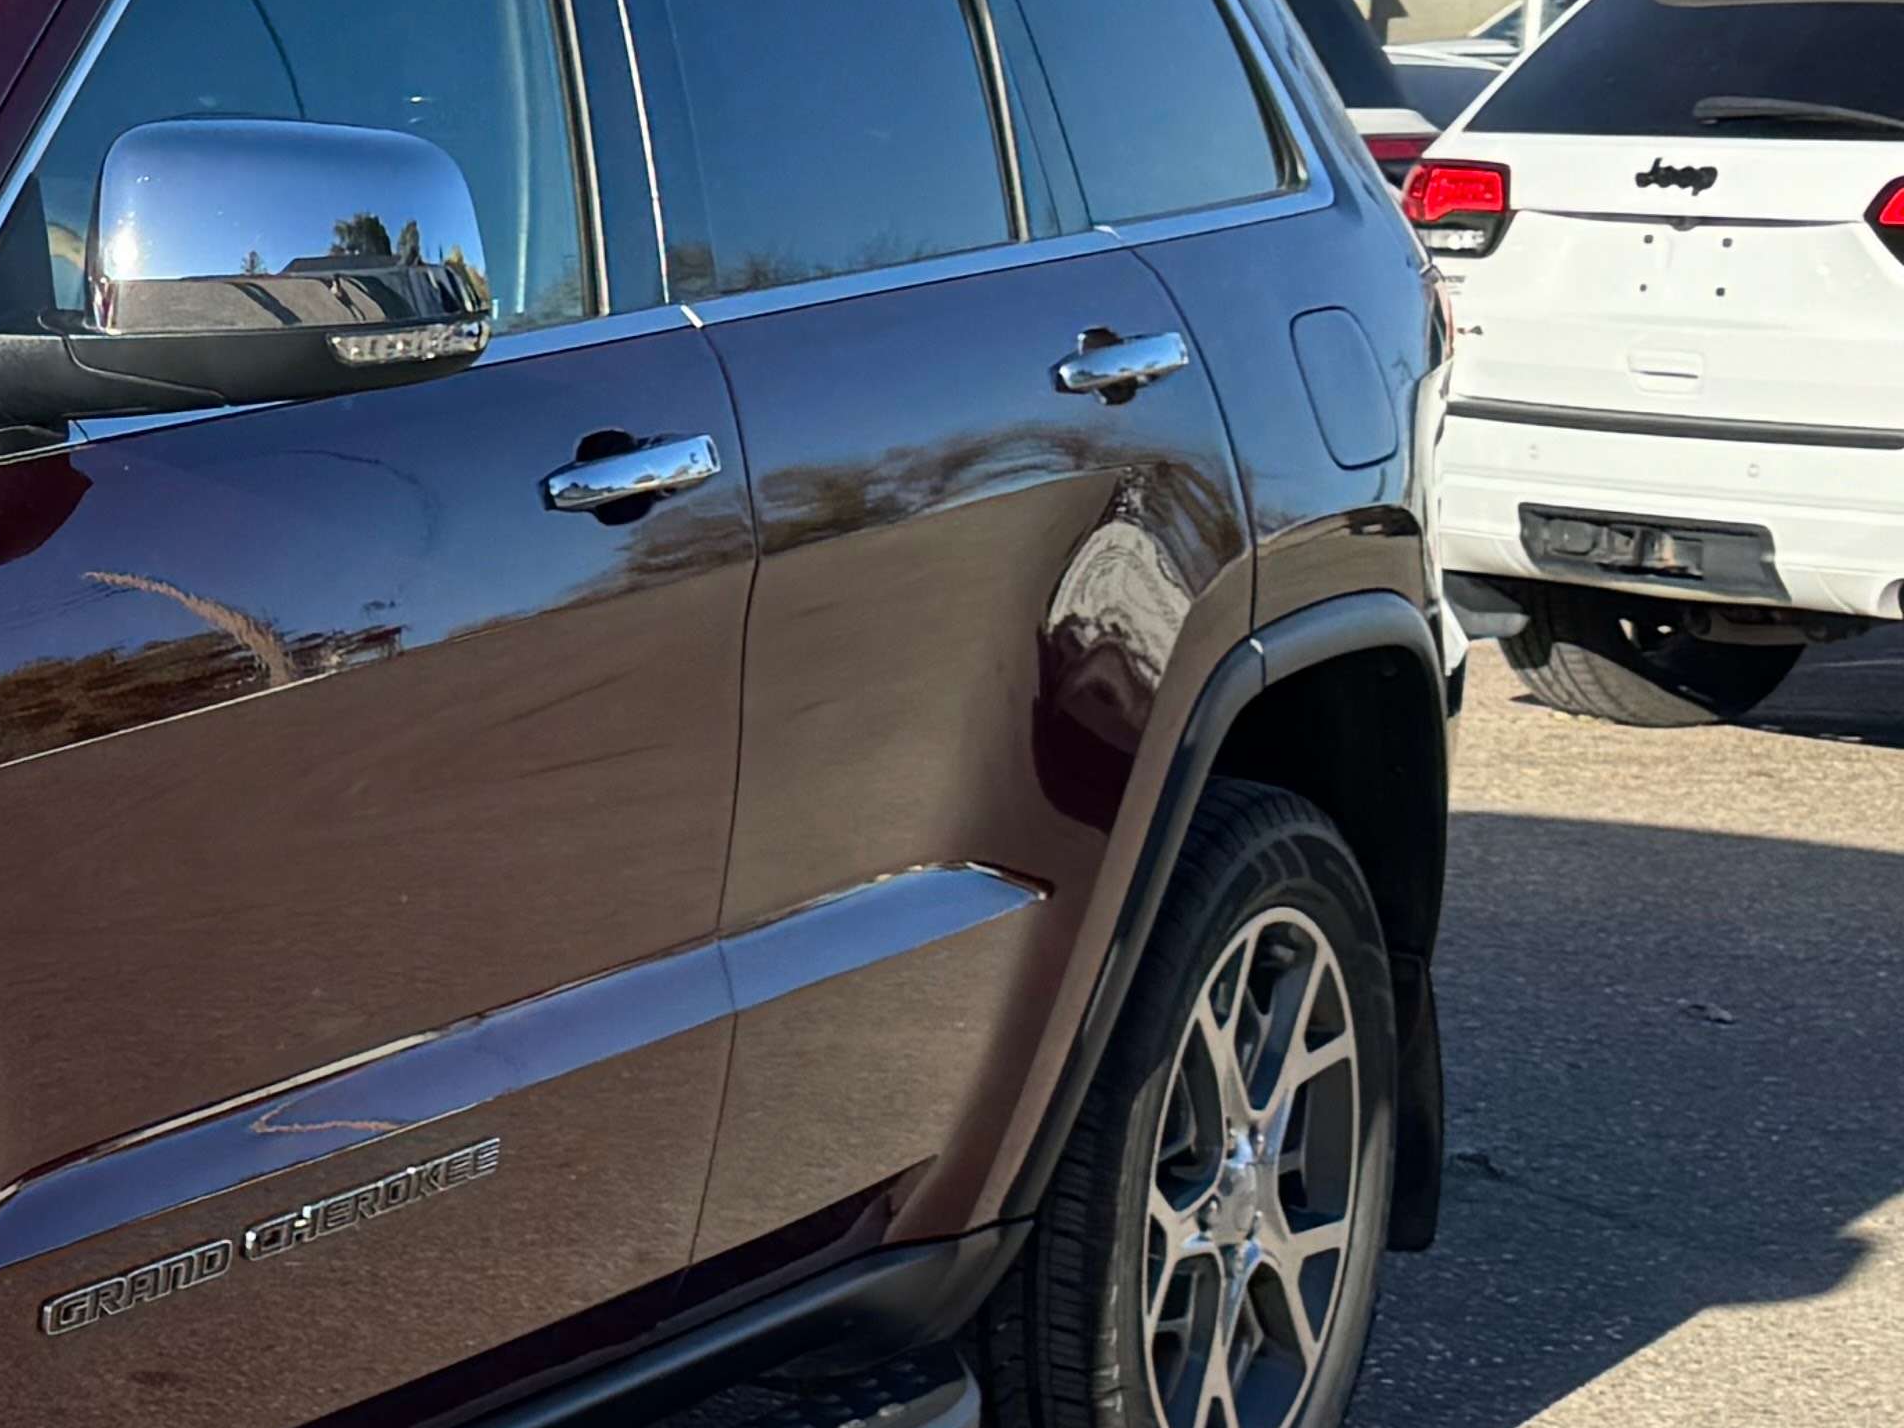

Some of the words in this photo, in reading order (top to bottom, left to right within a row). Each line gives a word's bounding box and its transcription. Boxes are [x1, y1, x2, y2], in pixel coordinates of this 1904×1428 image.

[1635, 157, 1718, 197] Jeep
[42, 1238, 233, 1336] GRAND
[242, 1137, 500, 1261] CHEROKEE
